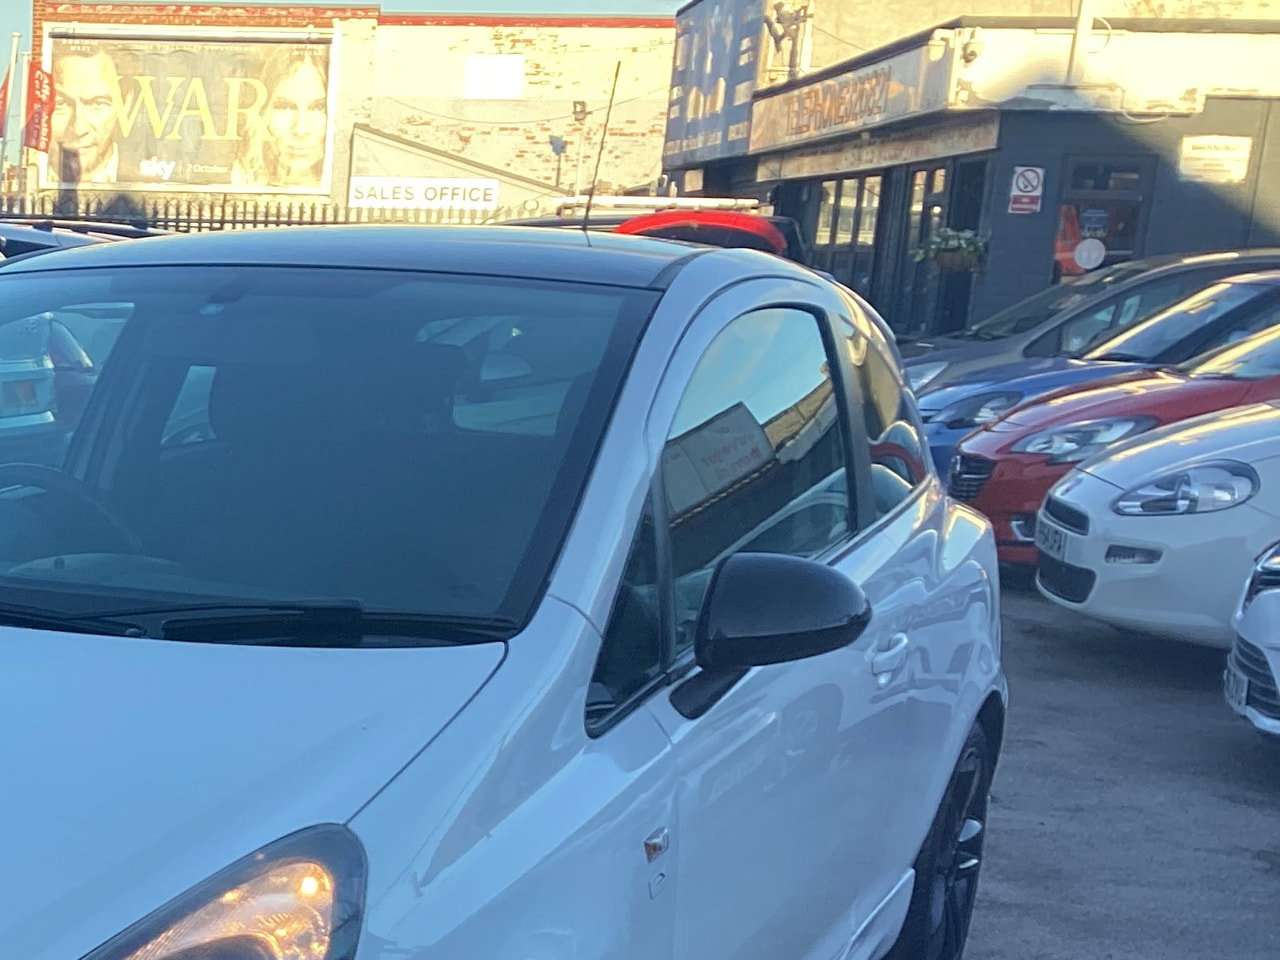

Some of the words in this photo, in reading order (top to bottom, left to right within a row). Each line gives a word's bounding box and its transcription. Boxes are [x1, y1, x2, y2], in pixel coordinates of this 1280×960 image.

[116, 74, 273, 141] WAR
[138, 157, 176, 180] sky
[354, 186, 415, 200] SALES
[424, 187, 493, 202] OFFICE
